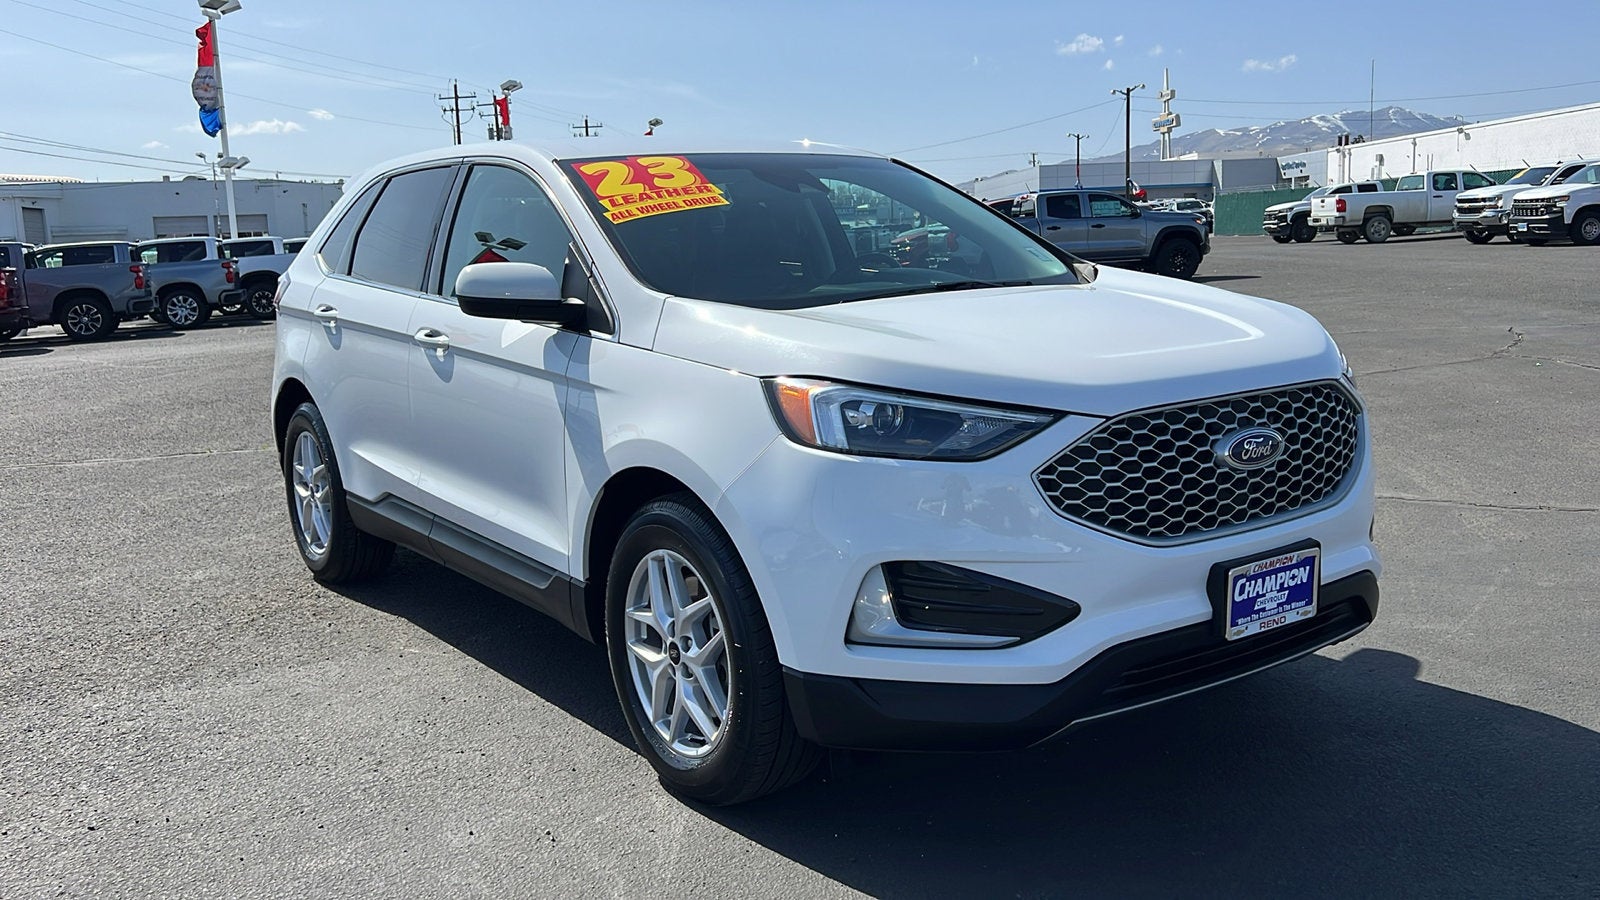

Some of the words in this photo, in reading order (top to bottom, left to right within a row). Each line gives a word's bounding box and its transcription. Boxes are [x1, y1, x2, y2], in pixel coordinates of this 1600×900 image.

[579, 156, 697, 197] 23
[608, 185, 712, 207] LEATHER
[610, 208, 637, 222] ALL
[636, 202, 682, 216] WHEEL
[685, 195, 721, 207] DRIVE
[1241, 437, 1273, 460] Ford
[1253, 554, 1295, 572] CHAMPION
[1234, 566, 1310, 602] CHAMPION
[1256, 593, 1286, 607] CHEVROLET
[1283, 603, 1291, 611] The
[1259, 616, 1286, 630] RENO
